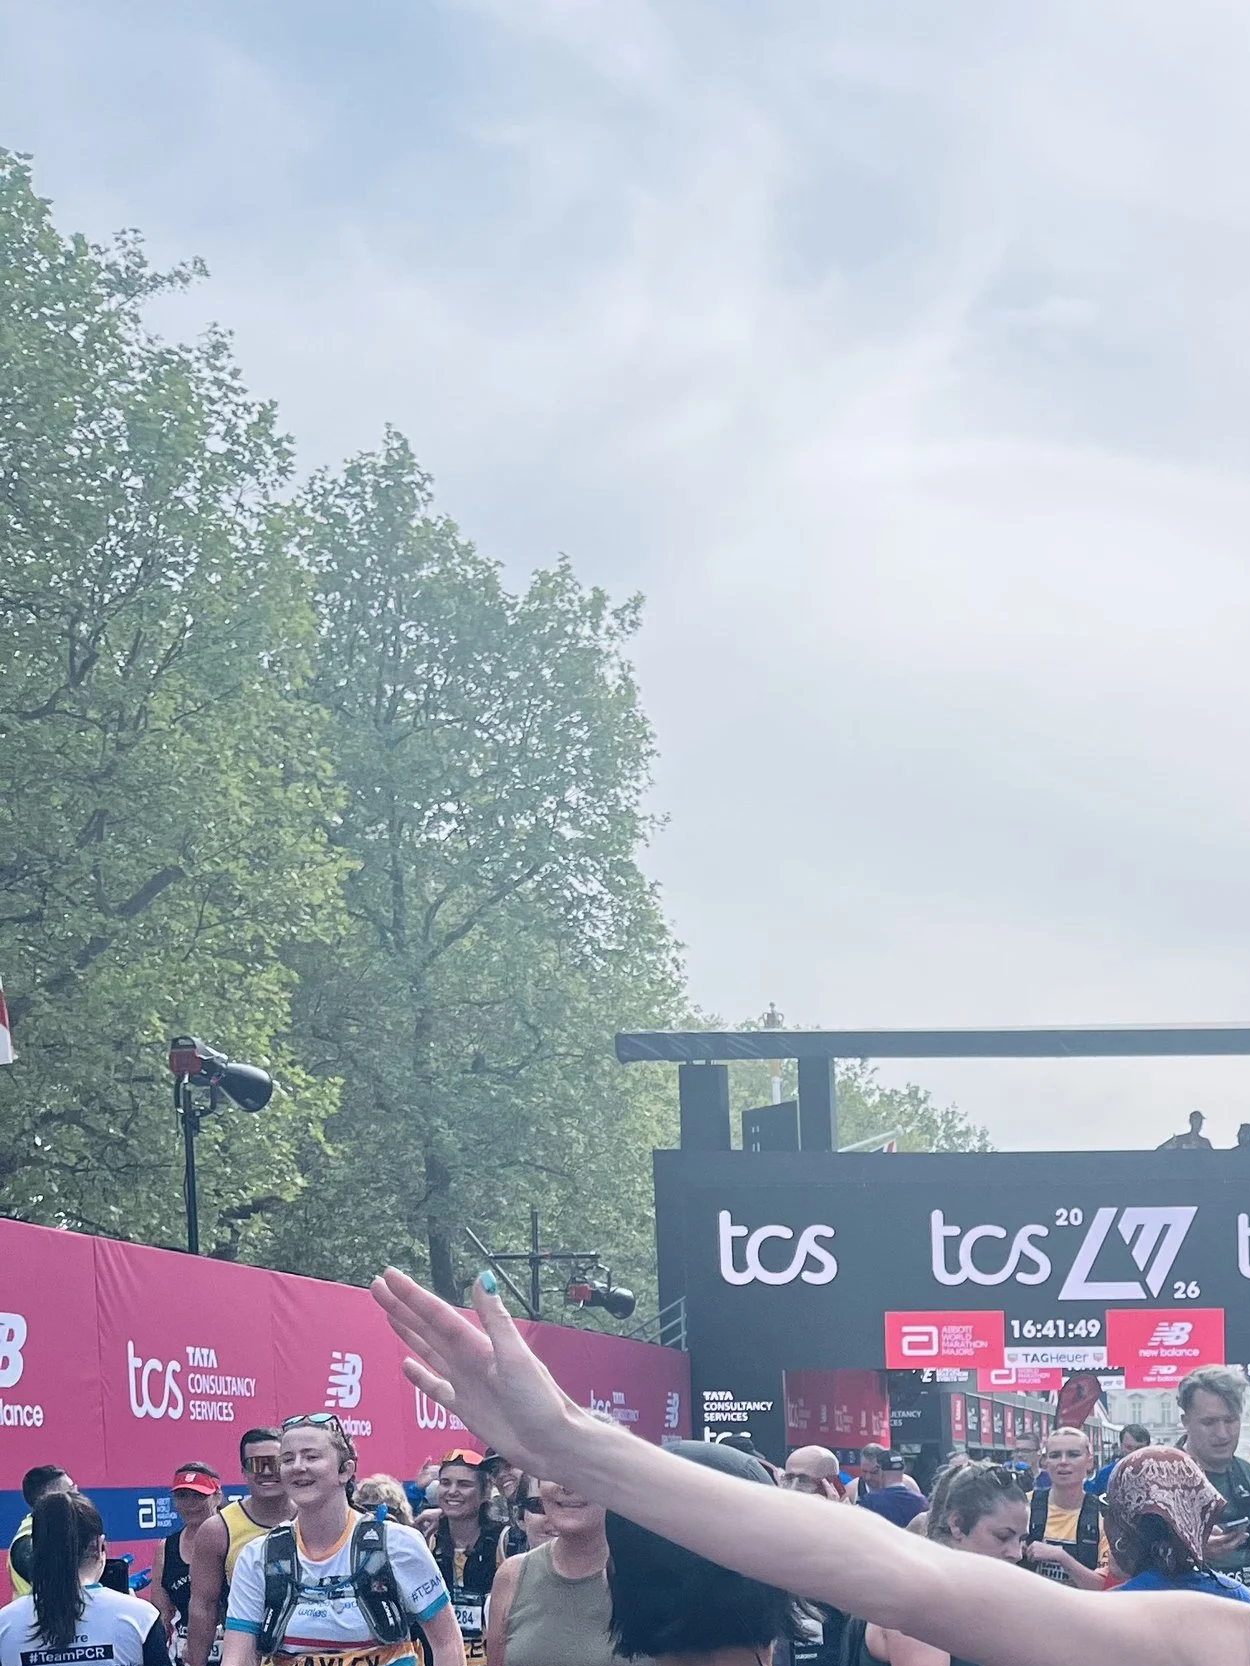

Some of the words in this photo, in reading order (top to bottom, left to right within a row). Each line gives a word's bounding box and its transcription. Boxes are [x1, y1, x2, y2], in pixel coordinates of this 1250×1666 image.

[1055, 1208, 1084, 1227] 20
[719, 1209, 839, 1286] tcs
[931, 1209, 1052, 1286] tcs
[1173, 1280, 1201, 1299] 26
[1011, 1319, 1101, 1339] 16:41:49
[0, 1312, 27, 1388] B
[942, 1341, 988, 1349] MARATHON
[1139, 1349, 1159, 1357] new
[1160, 1348, 1200, 1357] balance
[186, 1346, 218, 1368] TATA
[128, 1340, 184, 1420] tcs
[188, 1373, 256, 1397] CONSULTANCY
[703, 1391, 734, 1401] TATA
[189, 1401, 235, 1421] SERVICES
[703, 1401, 773, 1411] CONSULTANCY
[703, 1412, 748, 1421] SERVICES
[29, 1647, 105, 1663] #TeamPCR
